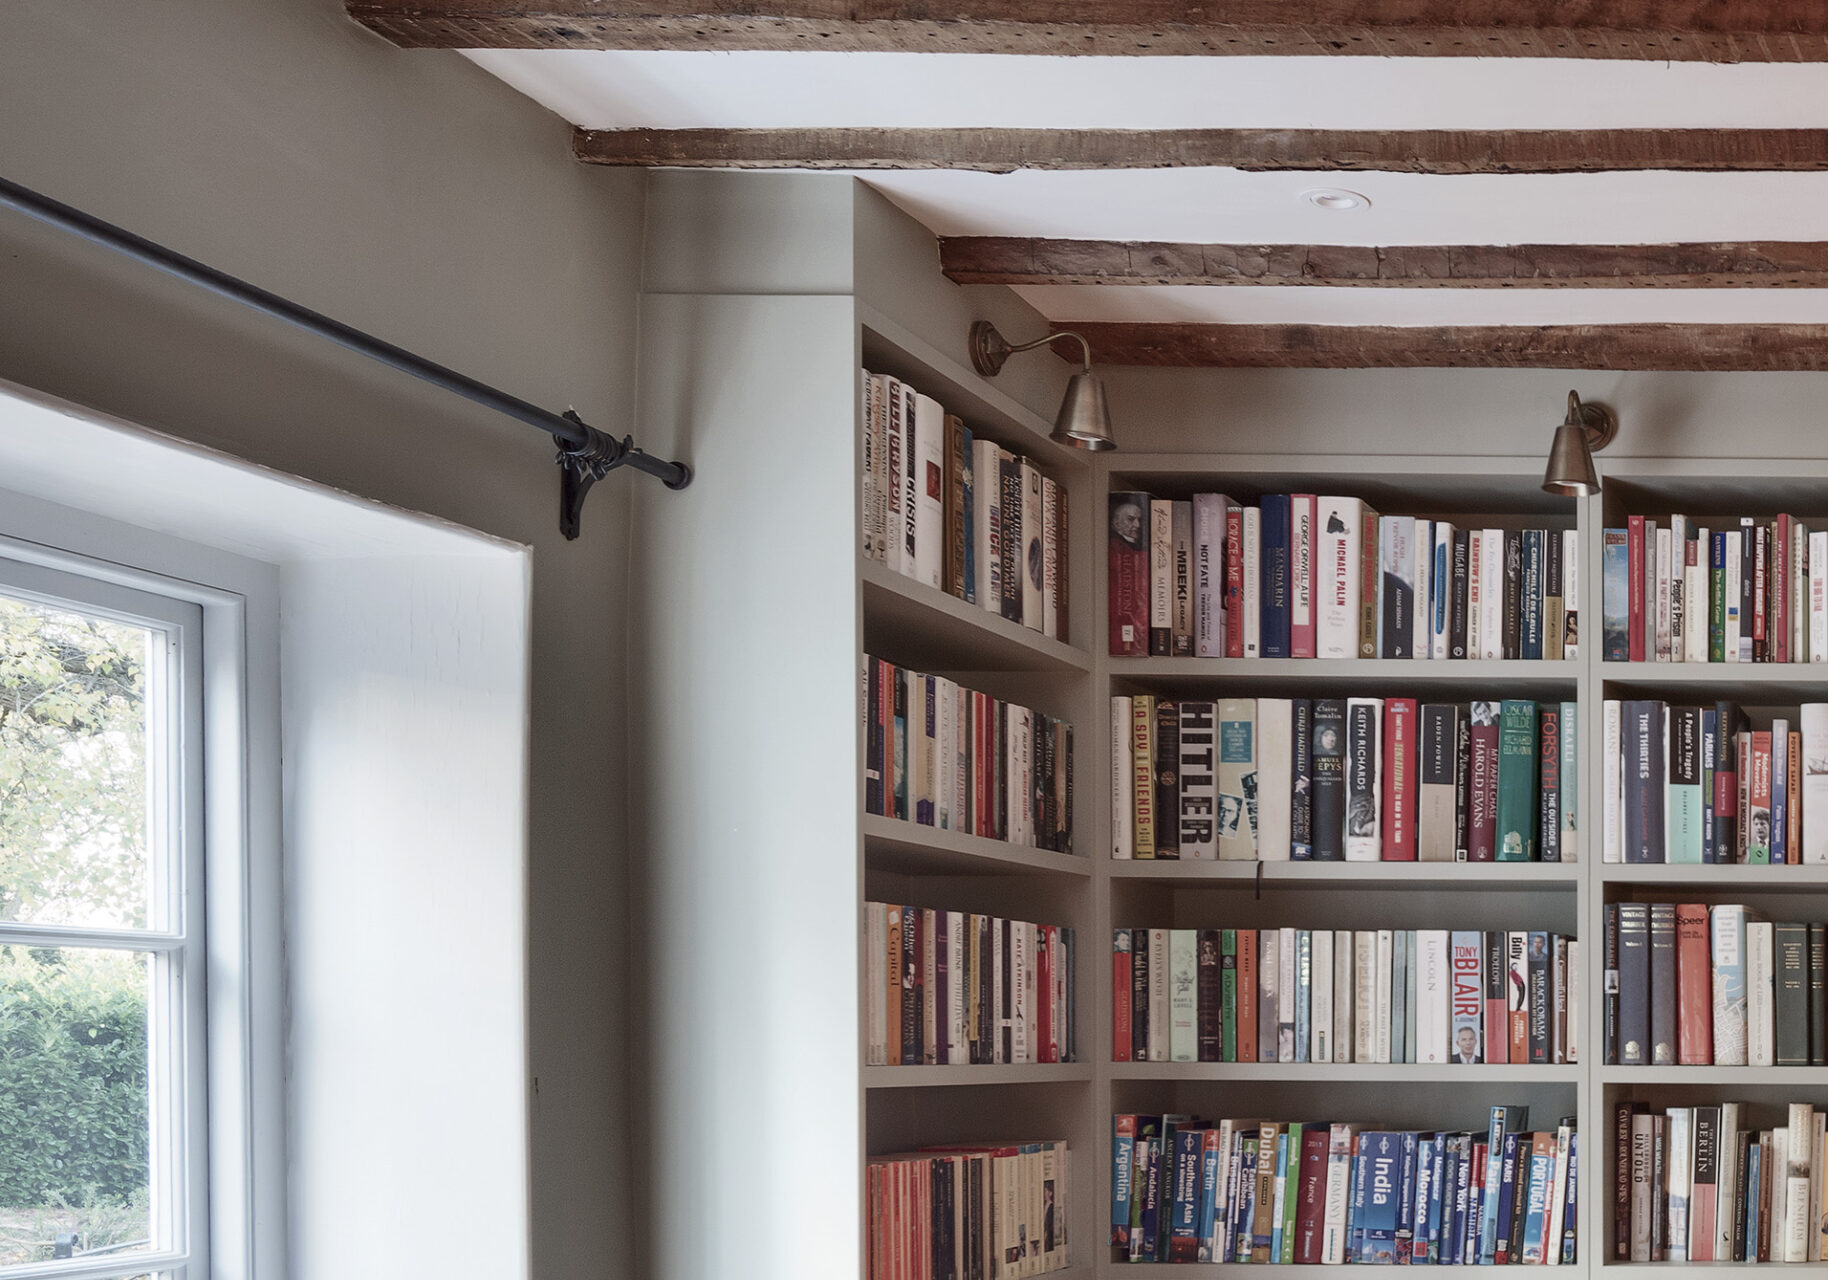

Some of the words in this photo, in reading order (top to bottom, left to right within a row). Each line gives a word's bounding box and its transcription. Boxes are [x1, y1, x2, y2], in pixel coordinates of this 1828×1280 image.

[890, 383, 900, 430] BILL
[890, 437, 900, 511] BRYSON
[906, 477, 915, 536] CRISIS
[1228, 519, 1239, 554] HORACE
[1301, 515, 1309, 548] GEORGE
[1755, 527, 1764, 543] WHAT
[1201, 545, 1209, 563] NOT
[1337, 539, 1346, 578] MICHAEL
[1454, 544, 1465, 579] MUGABE
[1472, 537, 1480, 584] RAINBOW'S
[1530, 548, 1538, 593] CHURCHILL
[1755, 544, 1764, 570] HAPPENS
[1177, 551, 1187, 601] MBEKI
[1200, 565, 1209, 588] FATE
[1229, 567, 1238, 582] ME
[1275, 548, 1284, 608] MANDARIN
[1755, 570, 1764, 588] AFTER
[1157, 577, 1166, 622] MEMOIRS
[1300, 594, 1308, 608] LIFE
[1337, 580, 1346, 607] PALIN
[1530, 601, 1536, 612] DE
[1671, 580, 1682, 611] People's
[1529, 613, 1537, 645] GAULLE
[1672, 613, 1682, 637] Prison
[1358, 707, 1367, 736] KEITH
[1505, 704, 1534, 716] OSCAR
[1505, 716, 1530, 729] WILDE
[1639, 713, 1649, 732] THE
[1135, 725, 1149, 750] SPY
[1543, 713, 1557, 789] FORSYTH
[1564, 708, 1574, 762] DISRAELI
[1685, 719, 1693, 750] People's
[1705, 733, 1713, 769] PARIAHS
[1357, 740, 1366, 791] RICHARDS
[1394, 742, 1404, 792] SENSATIONAL
[1475, 739, 1485, 787] HAROLD
[1491, 749, 1498, 761] MY
[1639, 734, 1649, 779] THIRTIES
[1684, 752, 1693, 780] Tragedy
[1181, 704, 1214, 844] HITLER
[1753, 758, 1762, 799] Mavericks
[1136, 767, 1150, 825] FRIENDS
[1474, 791, 1483, 829] EVANS
[1677, 915, 1705, 926] Speer
[889, 927, 900, 986] Capital
[1427, 941, 1438, 991] LINCOLN
[1455, 946, 1477, 958] TONY
[1492, 946, 1500, 985] TROLLOPE
[1511, 937, 1526, 960] Billy
[1454, 958, 1479, 1016] BLAIR
[1536, 970, 1545, 1006] BARACK
[1536, 1007, 1545, 1041] OBAMA
[1259, 1127, 1275, 1175] Dubai
[1634, 1133, 1643, 1183] UNTOLD
[1699, 1122, 1708, 1173] BERLIN
[1115, 1143, 1129, 1201] Argentina
[1147, 1166, 1157, 1210] Andalucía
[1185, 1154, 1196, 1201] Southeast
[1204, 1158, 1216, 1190] Berlin
[1240, 1168, 1250, 1209] Caribbean
[1358, 1156, 1368, 1189] Southern
[1373, 1158, 1393, 1205] India
[1432, 1156, 1442, 1201] Madagascar
[1459, 1162, 1469, 1187] New
[1488, 1161, 1500, 1194] Paris
[1504, 1159, 1513, 1183] PARIS
[1530, 1157, 1547, 1214] PORTUGAL
[1308, 1177, 1317, 1203] France
[1329, 1165, 1343, 1220] GERMANY
[1355, 1190, 1364, 1207] Italy
[1418, 1170, 1431, 1223] Morocco
[1456, 1188, 1468, 1212] York
[1184, 1203, 1194, 1224] Asia
[1797, 1184, 1807, 1240] BLENHEIM
